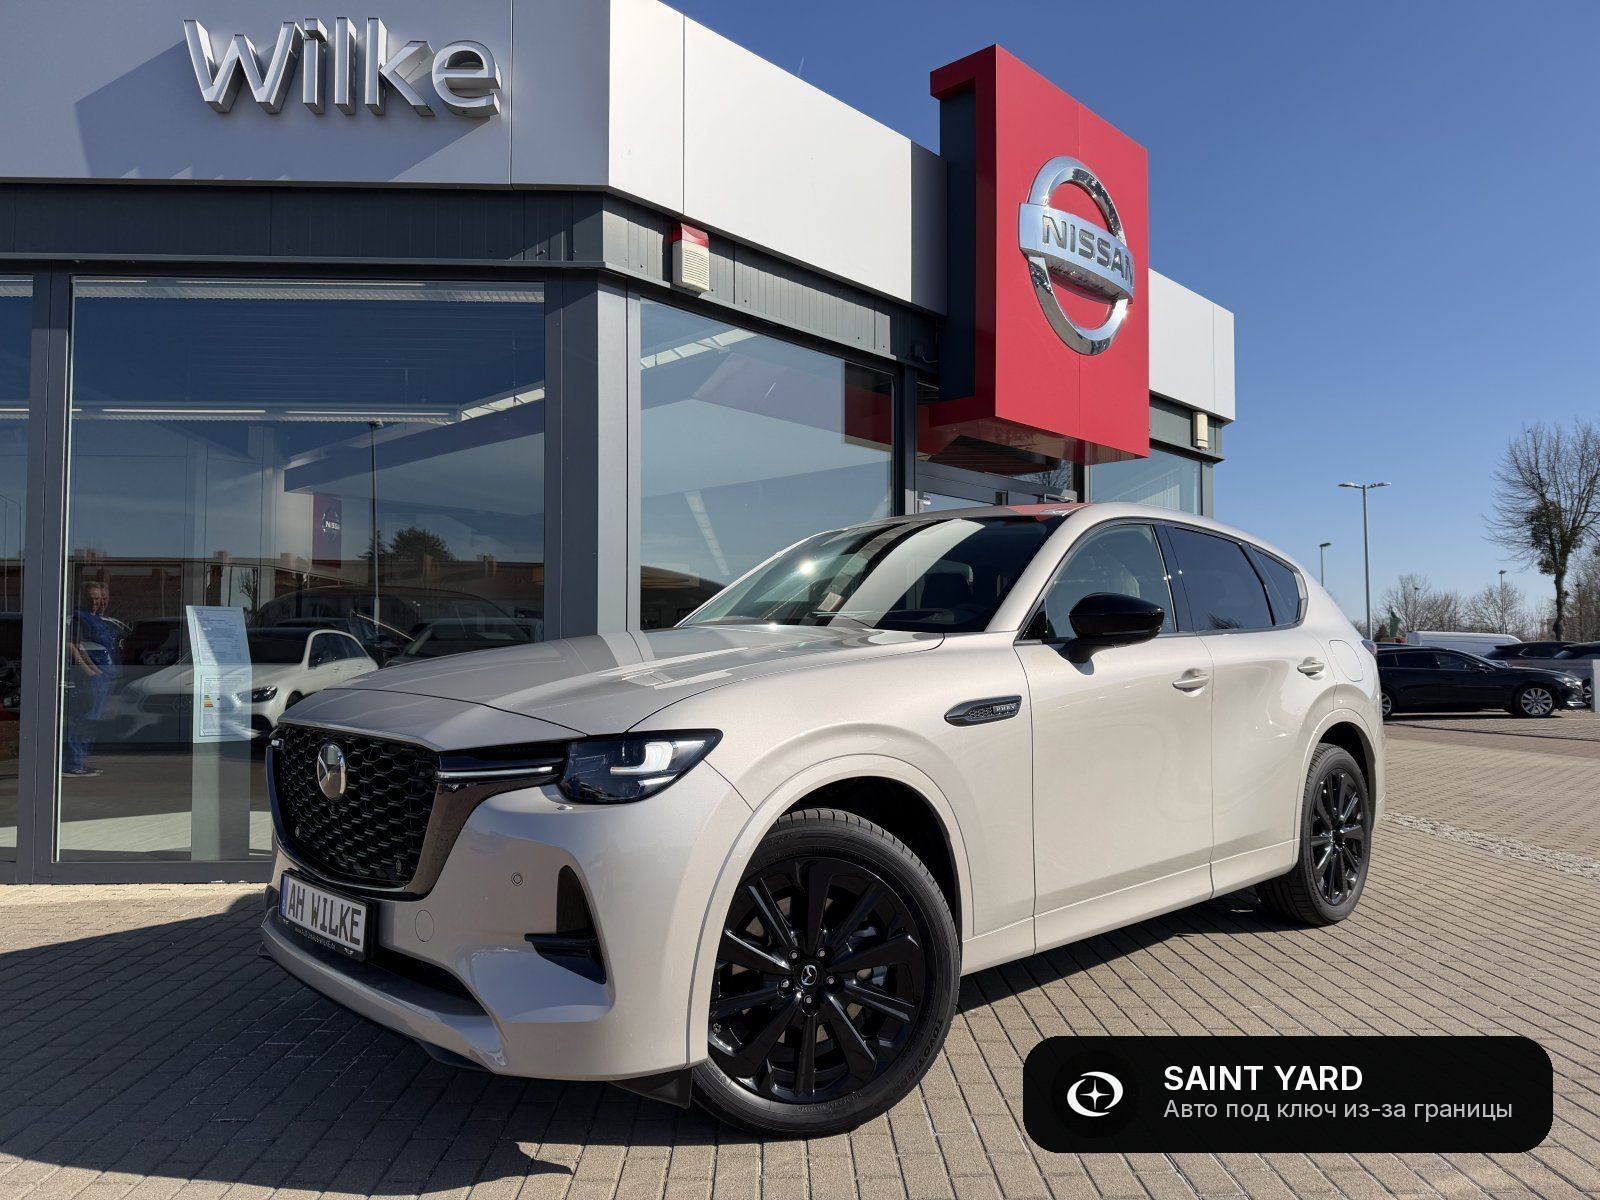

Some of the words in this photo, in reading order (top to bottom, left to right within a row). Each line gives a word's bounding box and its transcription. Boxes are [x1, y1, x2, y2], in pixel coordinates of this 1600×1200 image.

[183, 17, 502, 118] Wilke
[1042, 215, 1133, 287] NISSAN
[288, 882, 306, 922] AH
[311, 892, 362, 946] WILKE
